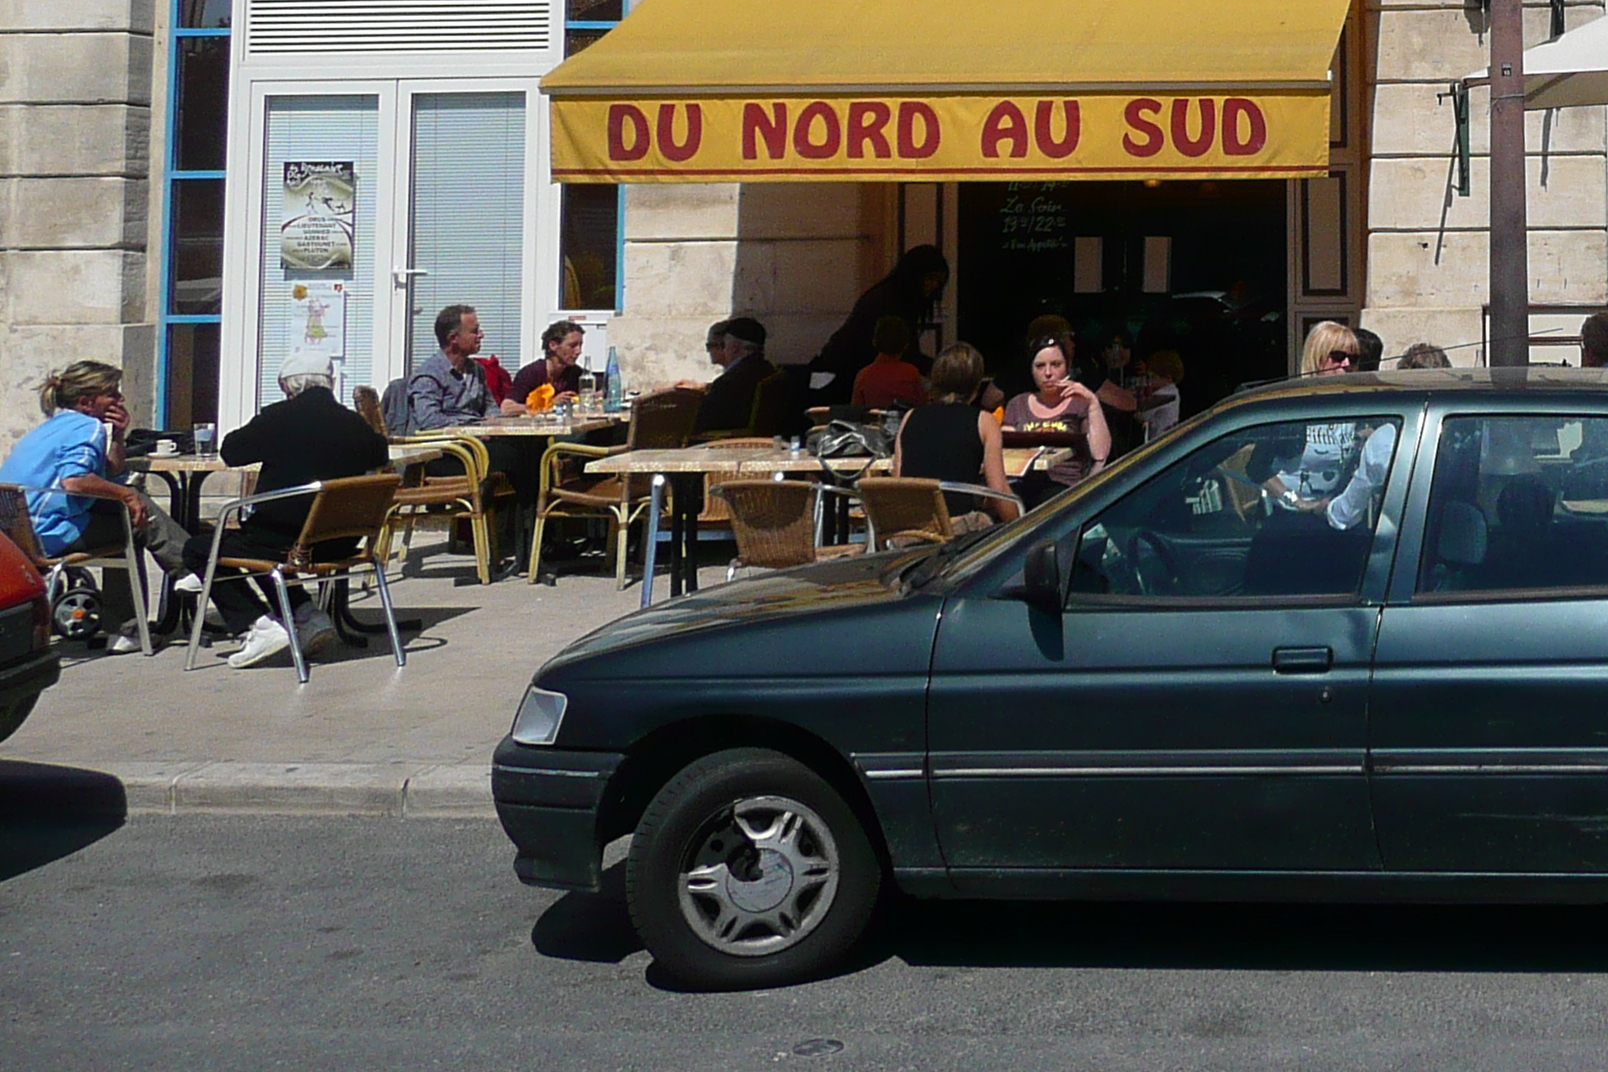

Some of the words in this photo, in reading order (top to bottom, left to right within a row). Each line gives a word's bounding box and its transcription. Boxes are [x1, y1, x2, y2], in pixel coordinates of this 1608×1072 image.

[607, 102, 702, 163] DU
[741, 101, 942, 161] NORD
[980, 99, 1081, 160] AU
[1121, 97, 1267, 158] SUD
